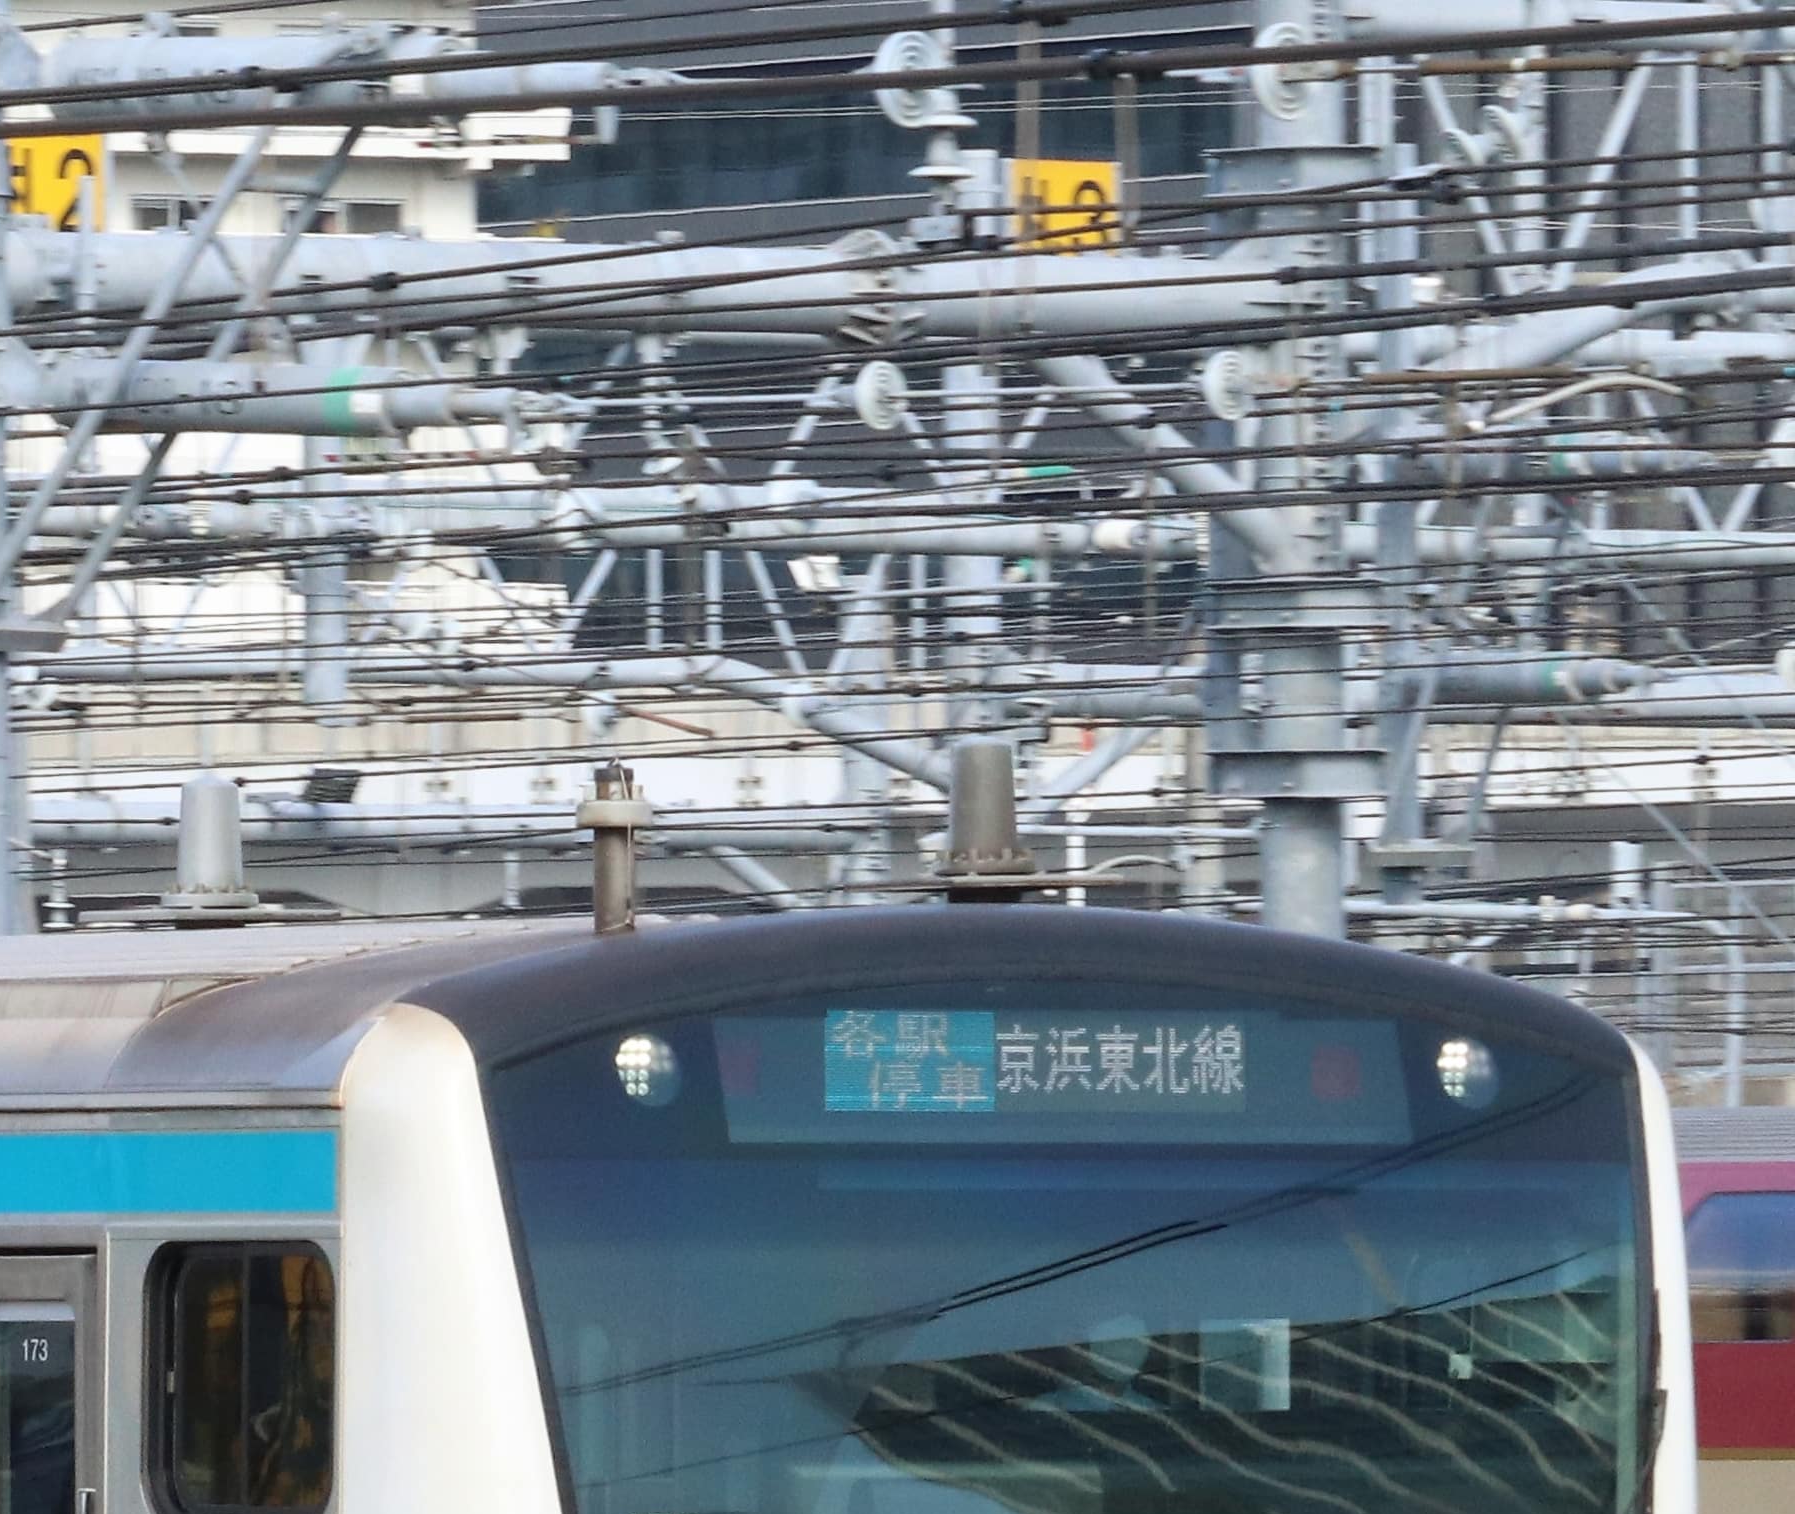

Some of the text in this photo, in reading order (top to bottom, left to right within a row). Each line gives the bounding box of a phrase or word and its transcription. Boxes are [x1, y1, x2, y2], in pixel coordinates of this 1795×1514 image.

[831, 1010, 949, 1058] 各駅
[996, 1023, 1244, 1095] 京浜東北線
[868, 1060, 989, 1109] 停車
[22, 1338, 48, 1361] 173
